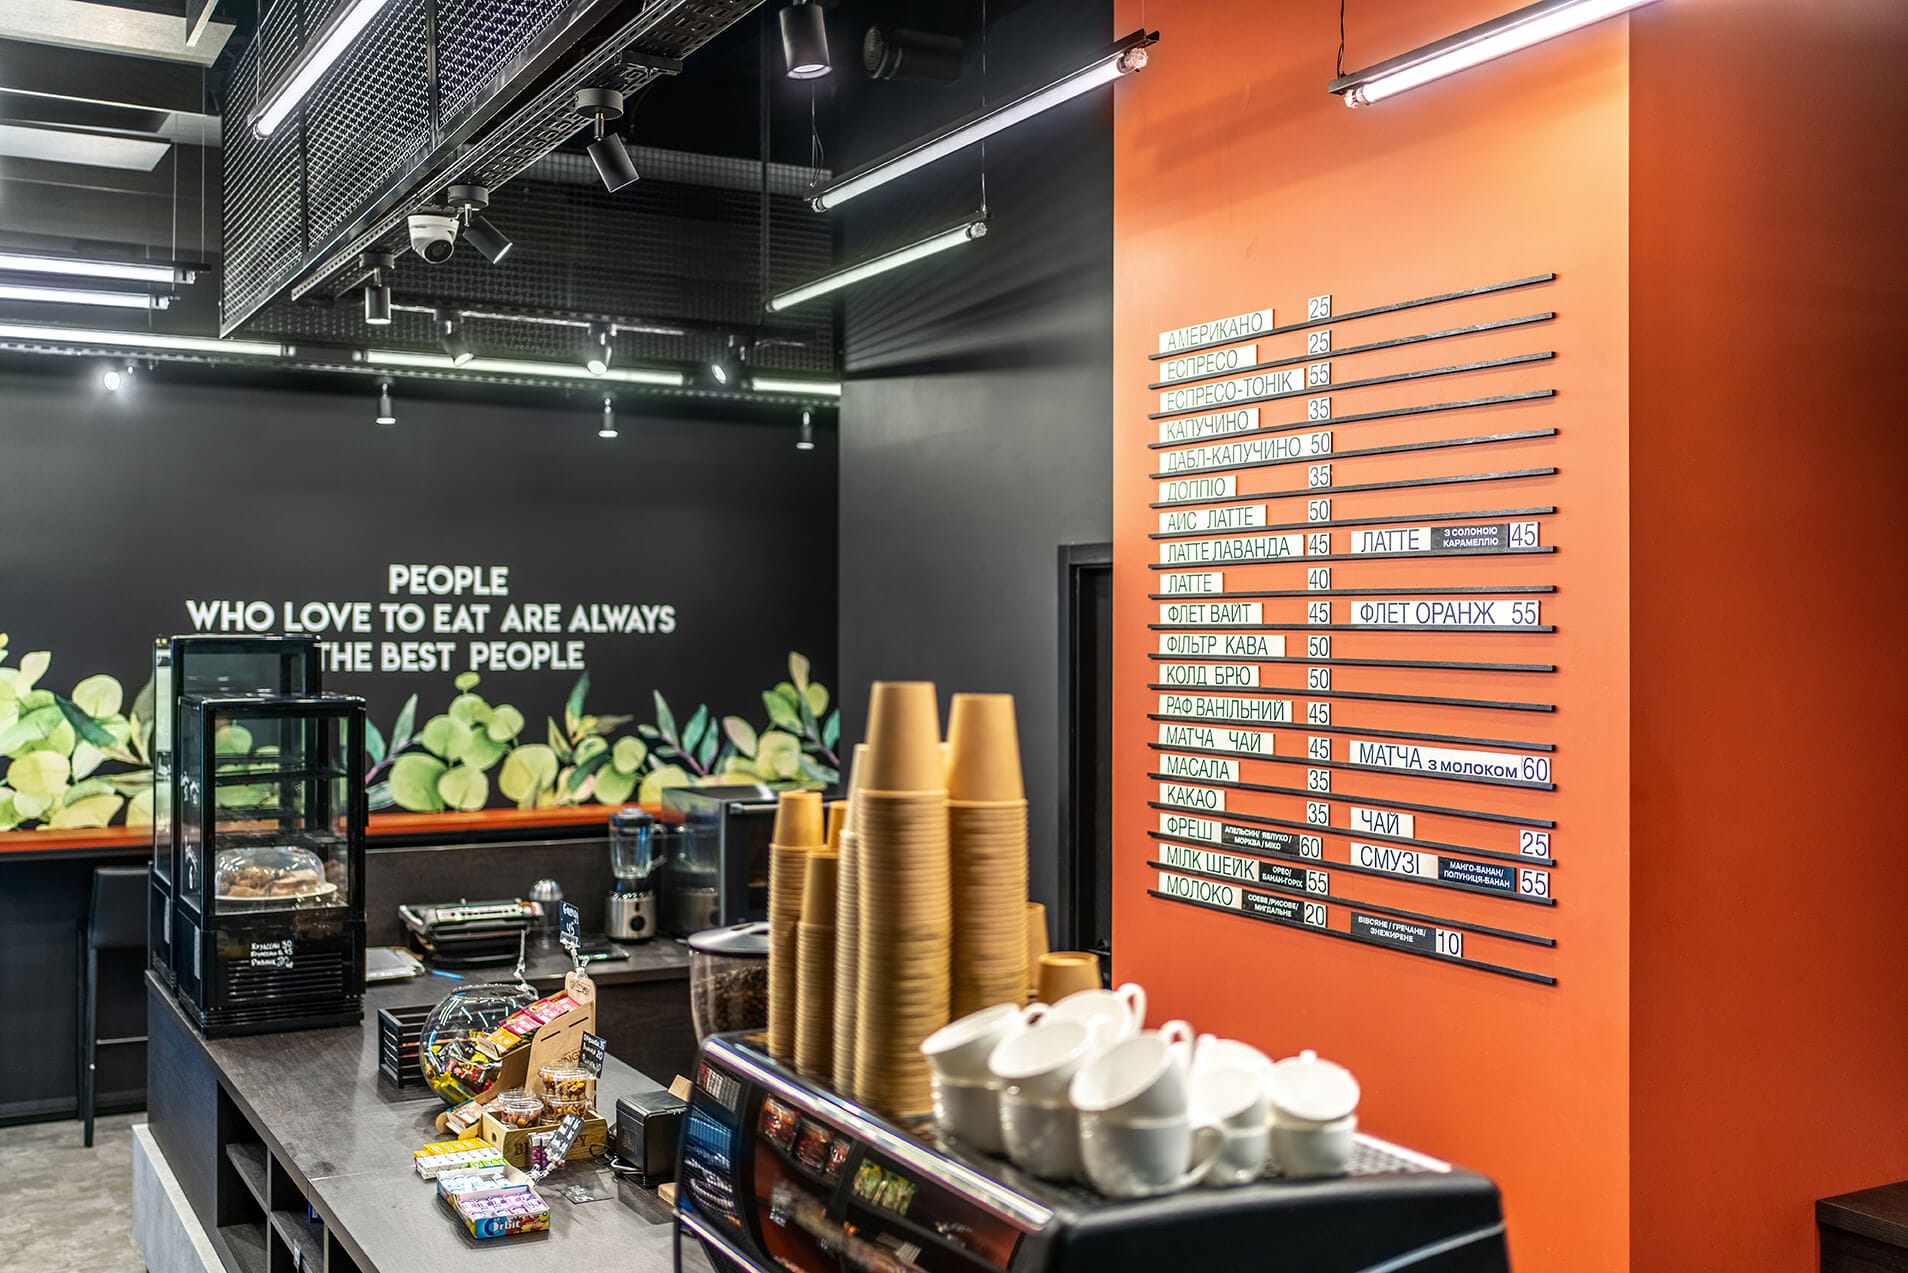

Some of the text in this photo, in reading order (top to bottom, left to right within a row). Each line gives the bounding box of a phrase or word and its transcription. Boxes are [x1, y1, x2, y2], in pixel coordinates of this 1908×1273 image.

[1168, 297, 1328, 350] АМЕРИКАНО 25
[1168, 332, 1328, 379] ЕСПРЕСО 25
[1168, 364, 1328, 410] ЕСПРЕСО-ТОНІК 55
[1167, 398, 1328, 440] КАПУЧИНО 35
[1168, 432, 1330, 472] ДАБЛ-КАПУЧИНО 50
[1168, 466, 1328, 502] ДОППІО 35
[1168, 500, 1328, 531] АЙС ЛАТТЕ 50
[1452, 526, 1498, 536] СОЛОНОЮ
[1168, 534, 1328, 562] ЛАТТЕ ЛАВАНДА 45
[1361, 523, 1536, 552] ЛАТТЕ 45
[1443, 538, 1498, 548] КАРАМЕЛЛЮ
[389, 564, 509, 595] PEOPLE
[1168, 570, 1328, 592] ЛАТТЕ 40
[186, 600, 676, 634] WHO LOVE TO EAT ARE ALWAYS
[1168, 602, 1328, 624] ФЛЕТ ВАЙТ 45
[1360, 602, 1536, 624] ФЛЕТ ОРАНЖ 55
[319, 640, 585, 672] THE BEST PEOPLE
[1167, 635, 1328, 656] ФІЛЬТР КАВА 50
[1167, 666, 1328, 688] КОЛД БРЮ 50
[1166, 696, 1328, 724] РАФ ВАНІЛЬНИЙ 45
[1166, 726, 1328, 758] МАТЧА ЧАЙ 45
[1168, 756, 1328, 791] МАСАЛА 35
[1360, 742, 1422, 768] МАТЧА
[1523, 758, 1548, 781] 60
[1168, 786, 1327, 824] КАКАО 35
[1167, 816, 1320, 858] ФРЕШ 60
[1361, 810, 1547, 856] ЧАЙ 25
[1167, 846, 1328, 894] МІЛК ШЕЙК 55
[1360, 846, 1546, 896] СМУЗІ 55
[1167, 875, 1325, 926] МОЛОКО 20
[1438, 932, 1460, 955] 10
[484, 1216, 521, 1237] Orbit
